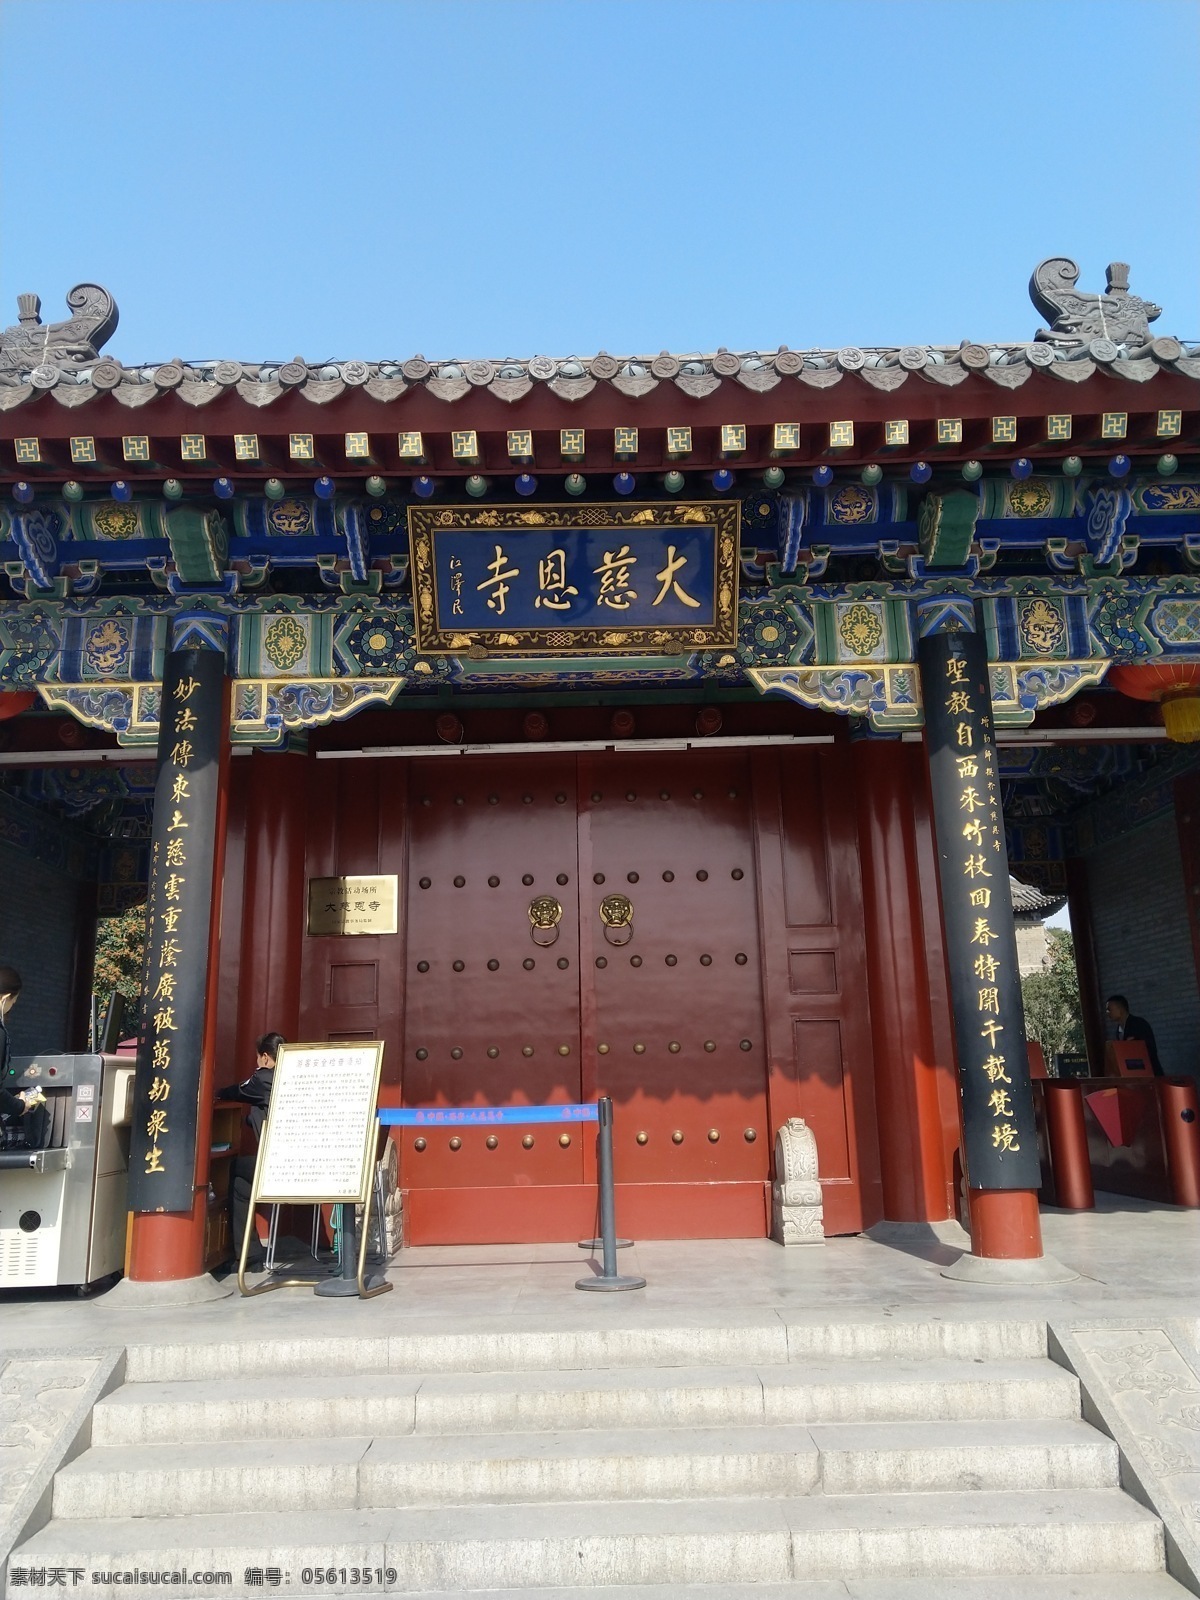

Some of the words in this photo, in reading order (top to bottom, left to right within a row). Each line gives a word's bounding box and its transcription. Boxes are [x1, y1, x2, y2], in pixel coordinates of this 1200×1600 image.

[476, 544, 701, 615] 大慈恩寺
[324, 900, 381, 912] 大慈恩寺
